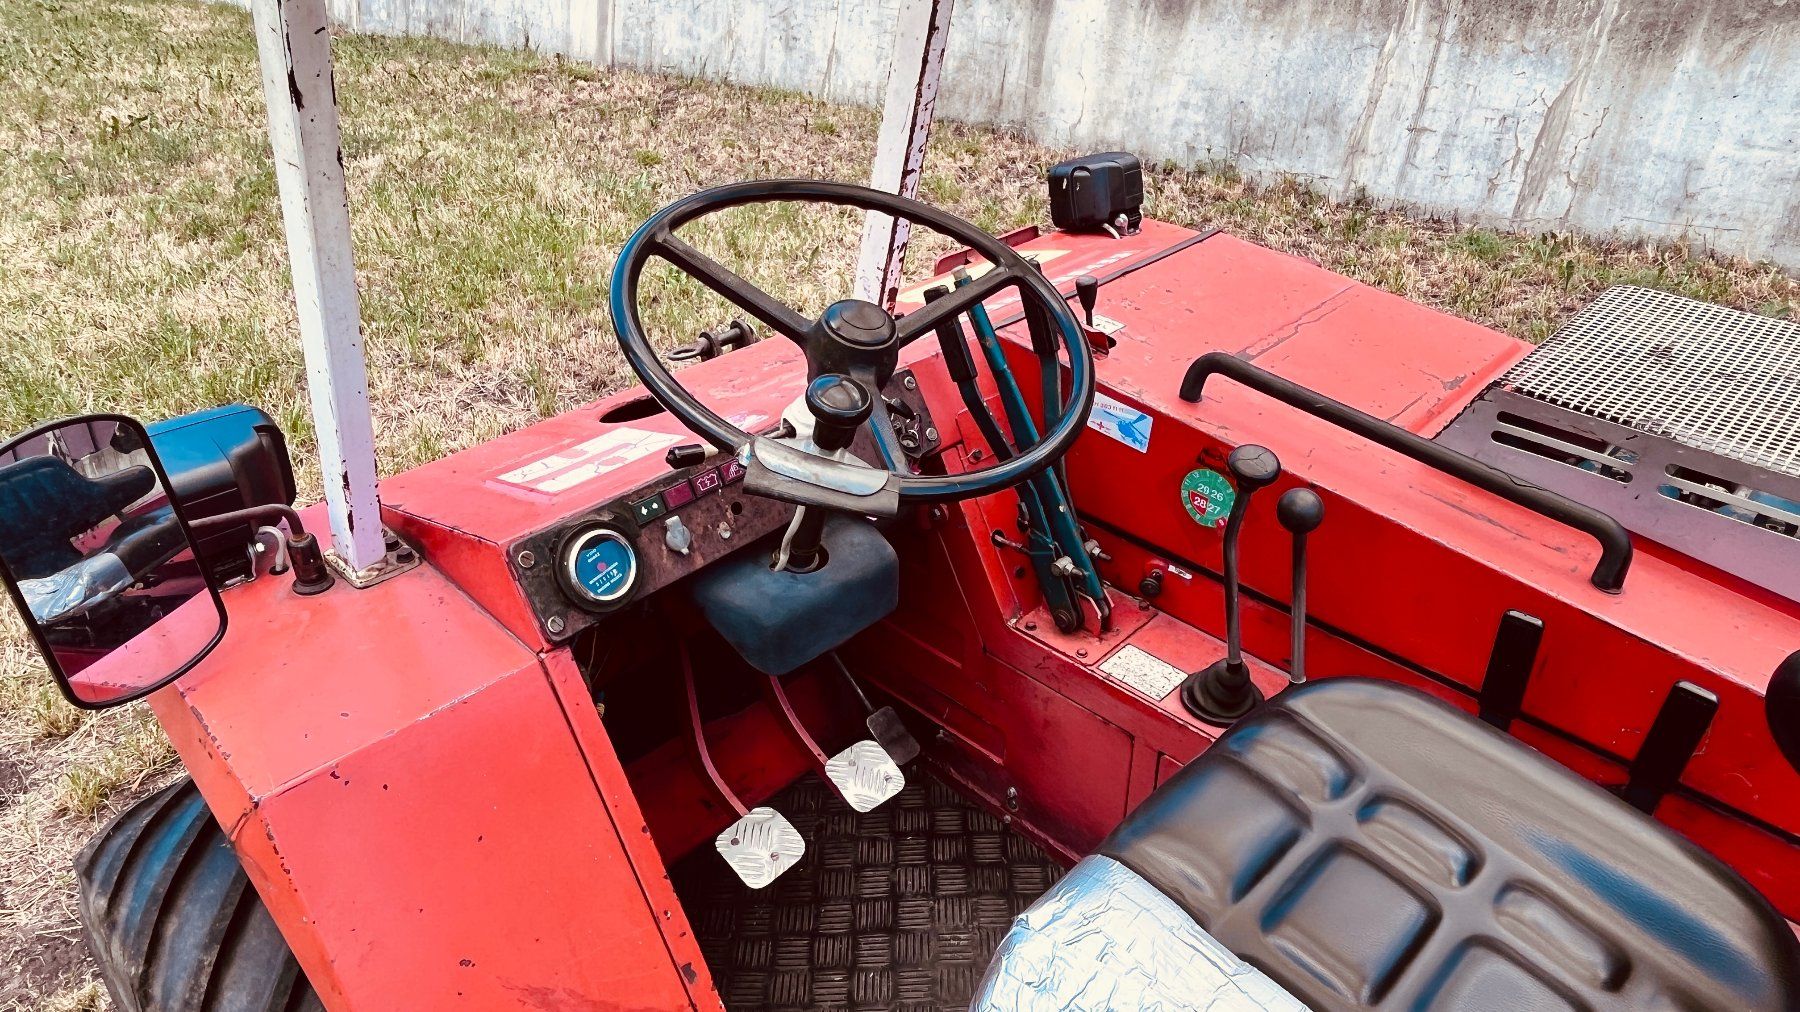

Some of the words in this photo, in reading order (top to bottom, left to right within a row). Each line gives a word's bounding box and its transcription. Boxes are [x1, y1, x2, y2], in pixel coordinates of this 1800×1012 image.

[1210, 489, 1224, 502] 26
[1193, 496, 1207, 509] 28
[1207, 502, 1221, 514] 27
